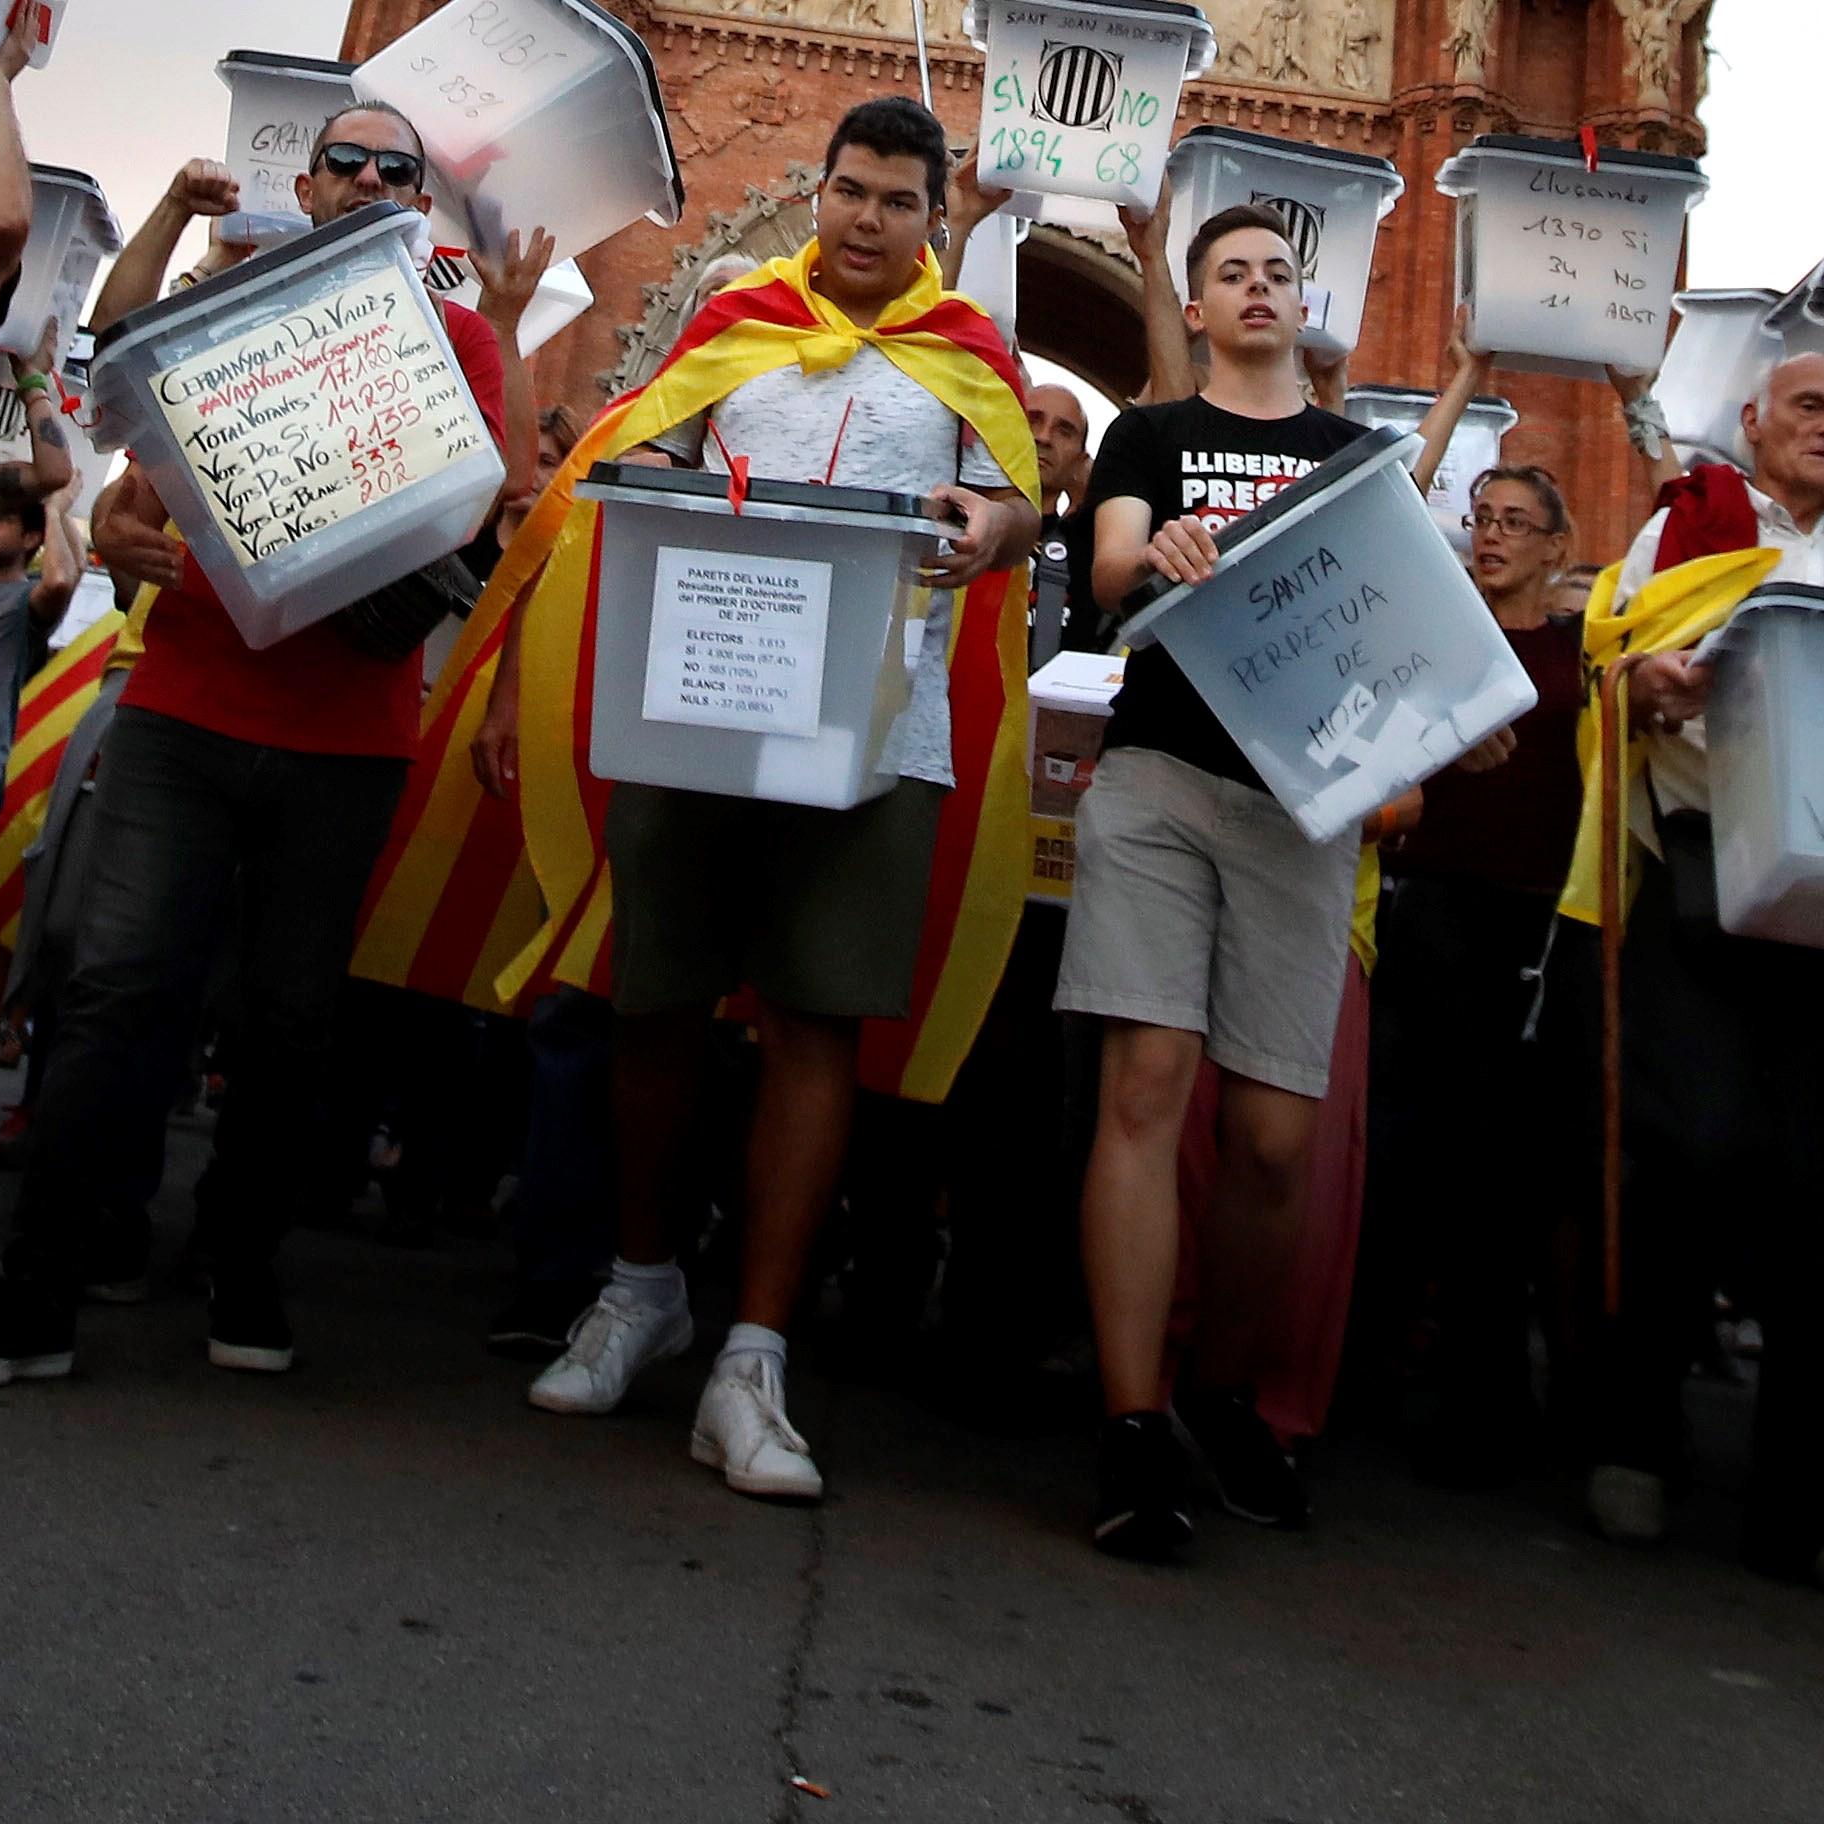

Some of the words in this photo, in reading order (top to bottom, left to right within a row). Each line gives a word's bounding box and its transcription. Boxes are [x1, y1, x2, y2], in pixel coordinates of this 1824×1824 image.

[1007, 11, 1049, 27] SANT
[439, 75, 504, 118] 85%
[993, 60, 1025, 112] SÍ
[1118, 89, 1160, 127] NO
[990, 127, 1063, 177] 1894
[1095, 143, 1142, 185] 68
[1523, 215, 1603, 241] 1390
[1549, 255, 1577, 280] 34
[1540, 294, 1571, 308] 11
[1606, 301, 1656, 325] ABST
[184, 424, 248, 454] TOTAL
[317, 342, 394, 392] 17.120
[326, 369, 411, 427] 14.250
[345, 398, 422, 452] 2.135
[351, 438, 404, 480] 533
[360, 461, 418, 505] 202
[1182, 478, 1290, 511] PRES
[677, 579, 725, 595] Resultats
[726, 583, 744, 595] del
[745, 586, 807, 603] Referèndum
[687, 567, 731, 583] PARETS
[732, 572, 754, 585] DEL
[1249, 547, 1342, 623] SANTA
[678, 593, 694, 604] del
[696, 593, 738, 609] PRIMER
[740, 598, 804, 616] D'OCTUBRE
[718, 611, 734, 621] DE
[736, 612, 760, 624] 2017
[686, 629, 744, 645] ELECTORS
[683, 662, 701, 672] NO
[1334, 639, 1372, 677] DE
[680, 693, 710, 706] NULS
[682, 677, 727, 691] BLANCS
